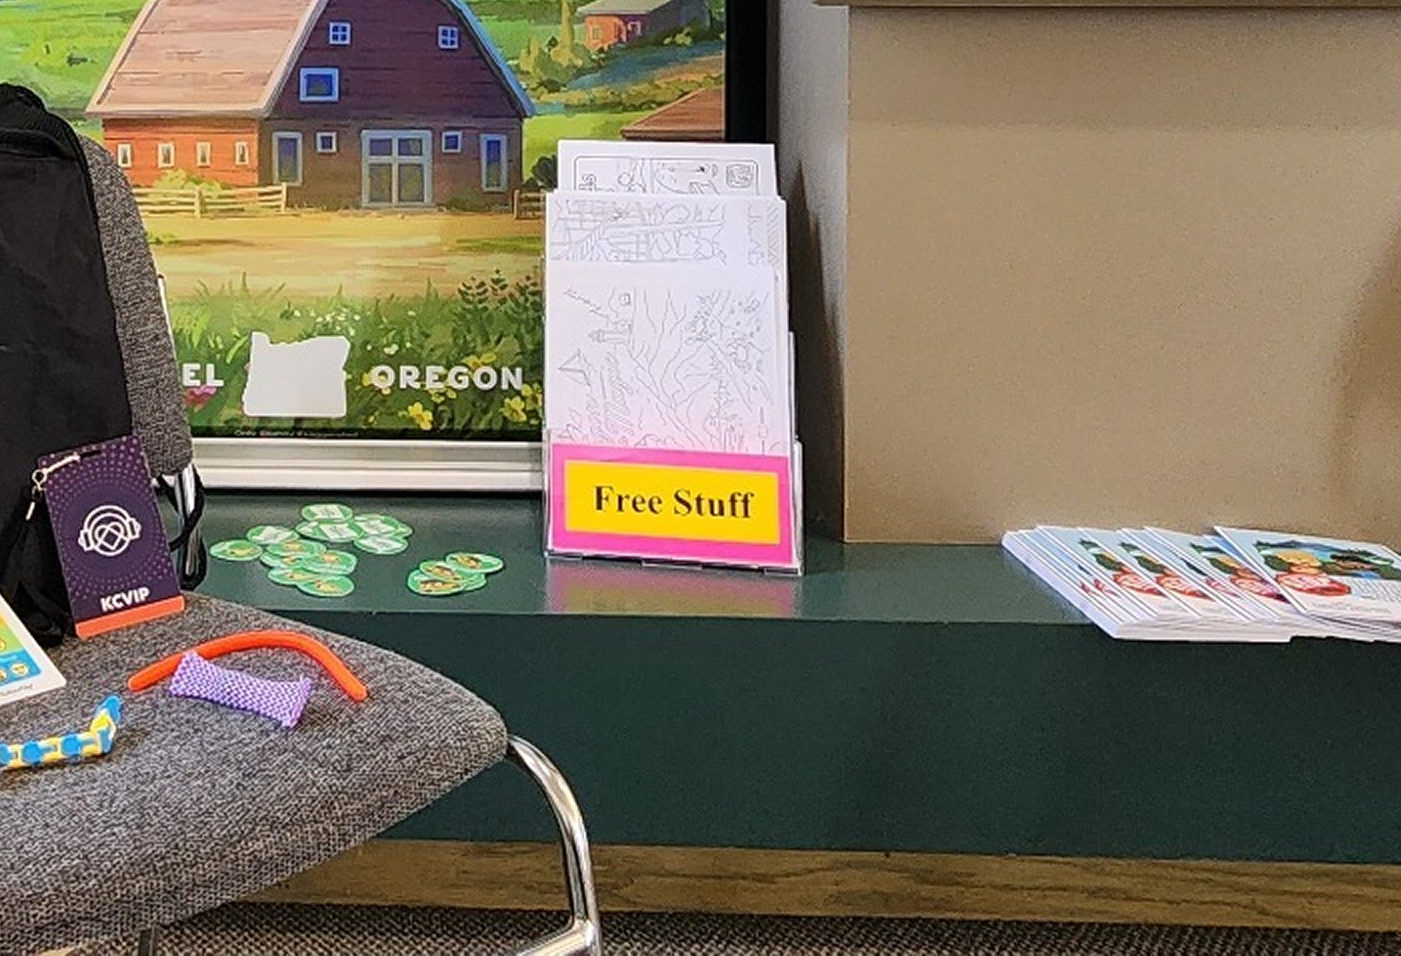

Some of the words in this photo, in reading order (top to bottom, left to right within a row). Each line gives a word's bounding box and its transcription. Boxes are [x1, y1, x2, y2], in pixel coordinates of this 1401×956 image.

[370, 365, 524, 391] OREGON
[593, 485, 663, 515] Free
[673, 487, 755, 519] Stuff
[100, 587, 151, 614] KCVIP
